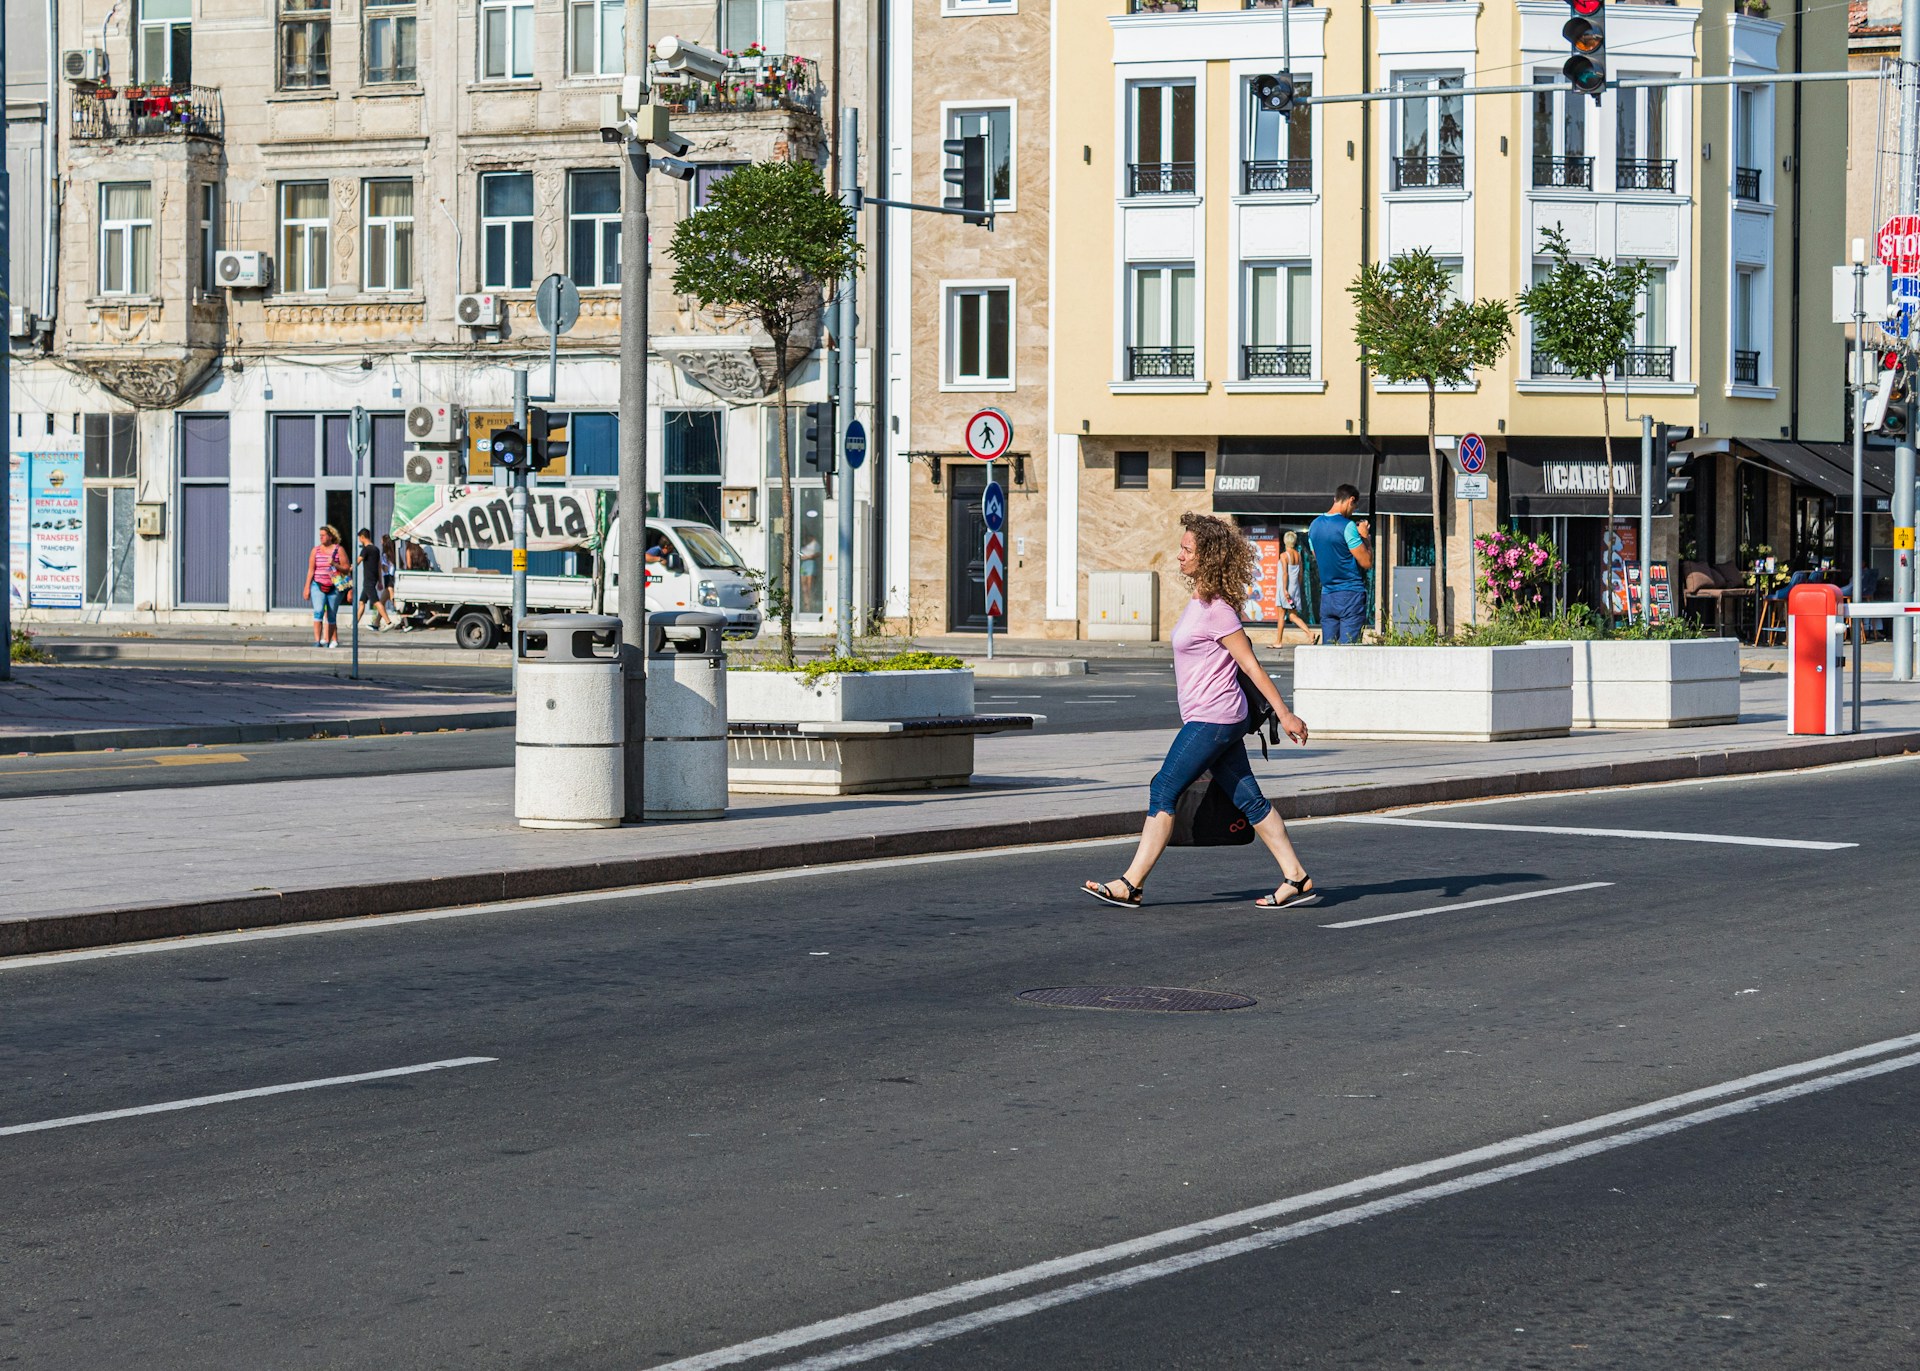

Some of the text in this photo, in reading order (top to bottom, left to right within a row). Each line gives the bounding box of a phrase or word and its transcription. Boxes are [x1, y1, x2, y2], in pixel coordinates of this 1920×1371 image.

[1881, 234, 1920, 256] STO
[1218, 478, 1255, 490] CARGO
[1382, 478, 1419, 490] CARGO
[1552, 464, 1628, 491] CARGO
[35, 499, 79, 507] RENT A CAR
[434, 488, 588, 549] mentza
